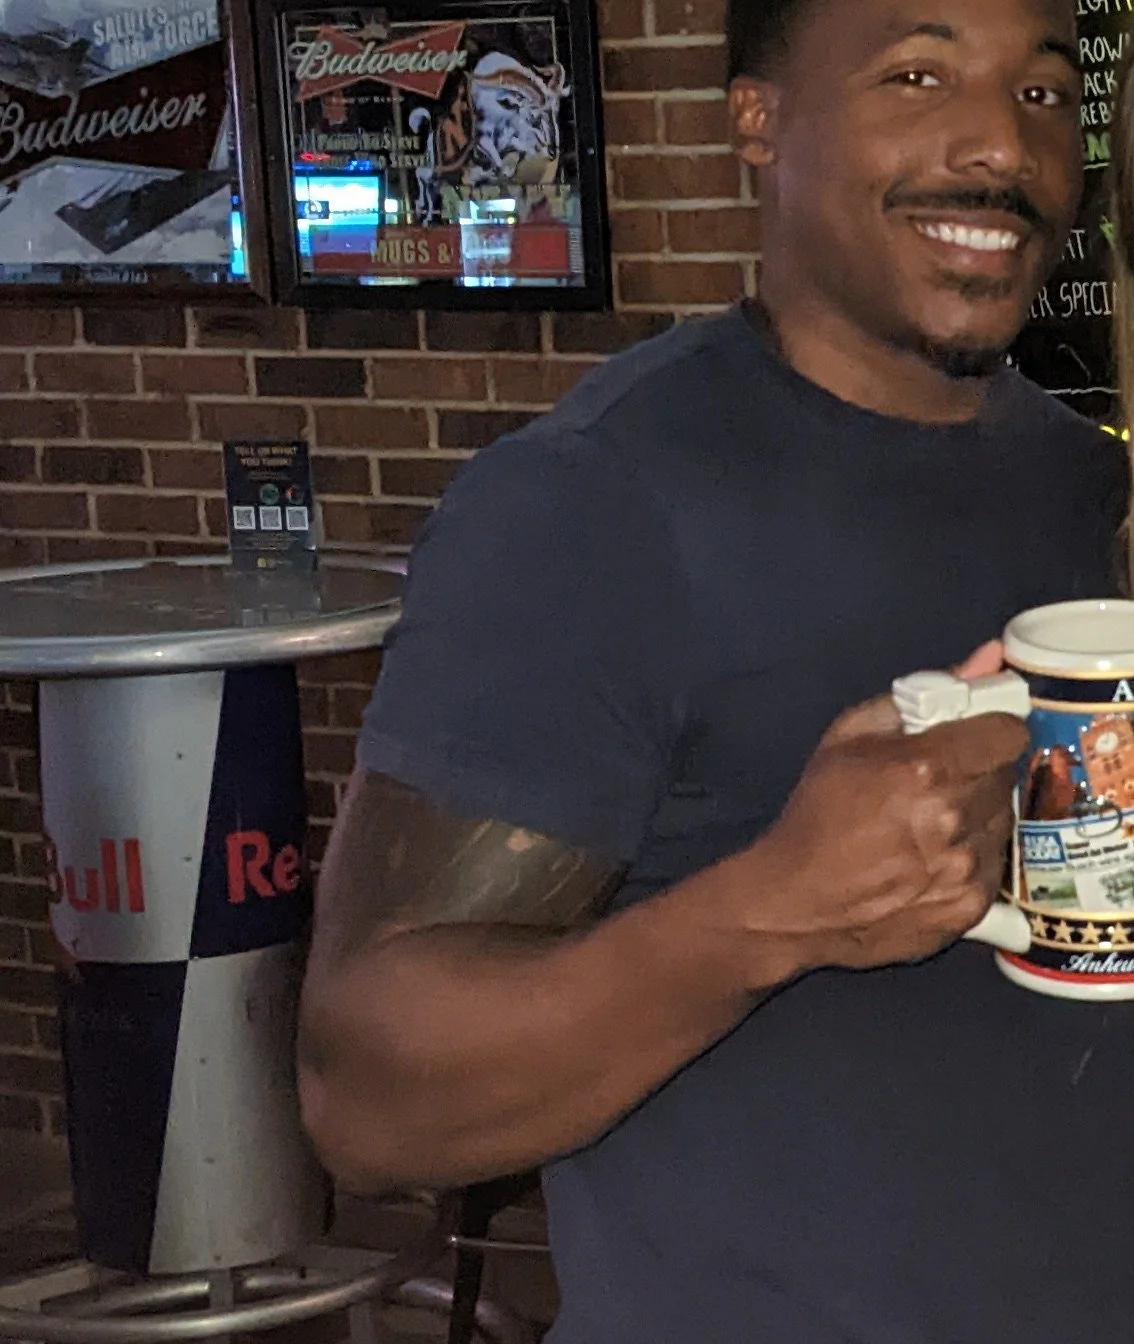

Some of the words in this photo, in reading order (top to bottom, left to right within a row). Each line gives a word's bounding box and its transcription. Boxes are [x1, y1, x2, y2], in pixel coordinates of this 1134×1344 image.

[93, 7, 168, 46] SALUTES
[153, 7, 220, 52] FORCE
[289, 42, 468, 80] Budweiser
[0, 87, 207, 163] Budweiser
[370, 241, 430, 264] MUGS
[438, 244, 452, 265] &
[1060, 281, 1117, 318] SPECI
[225, 830, 300, 905] Re
